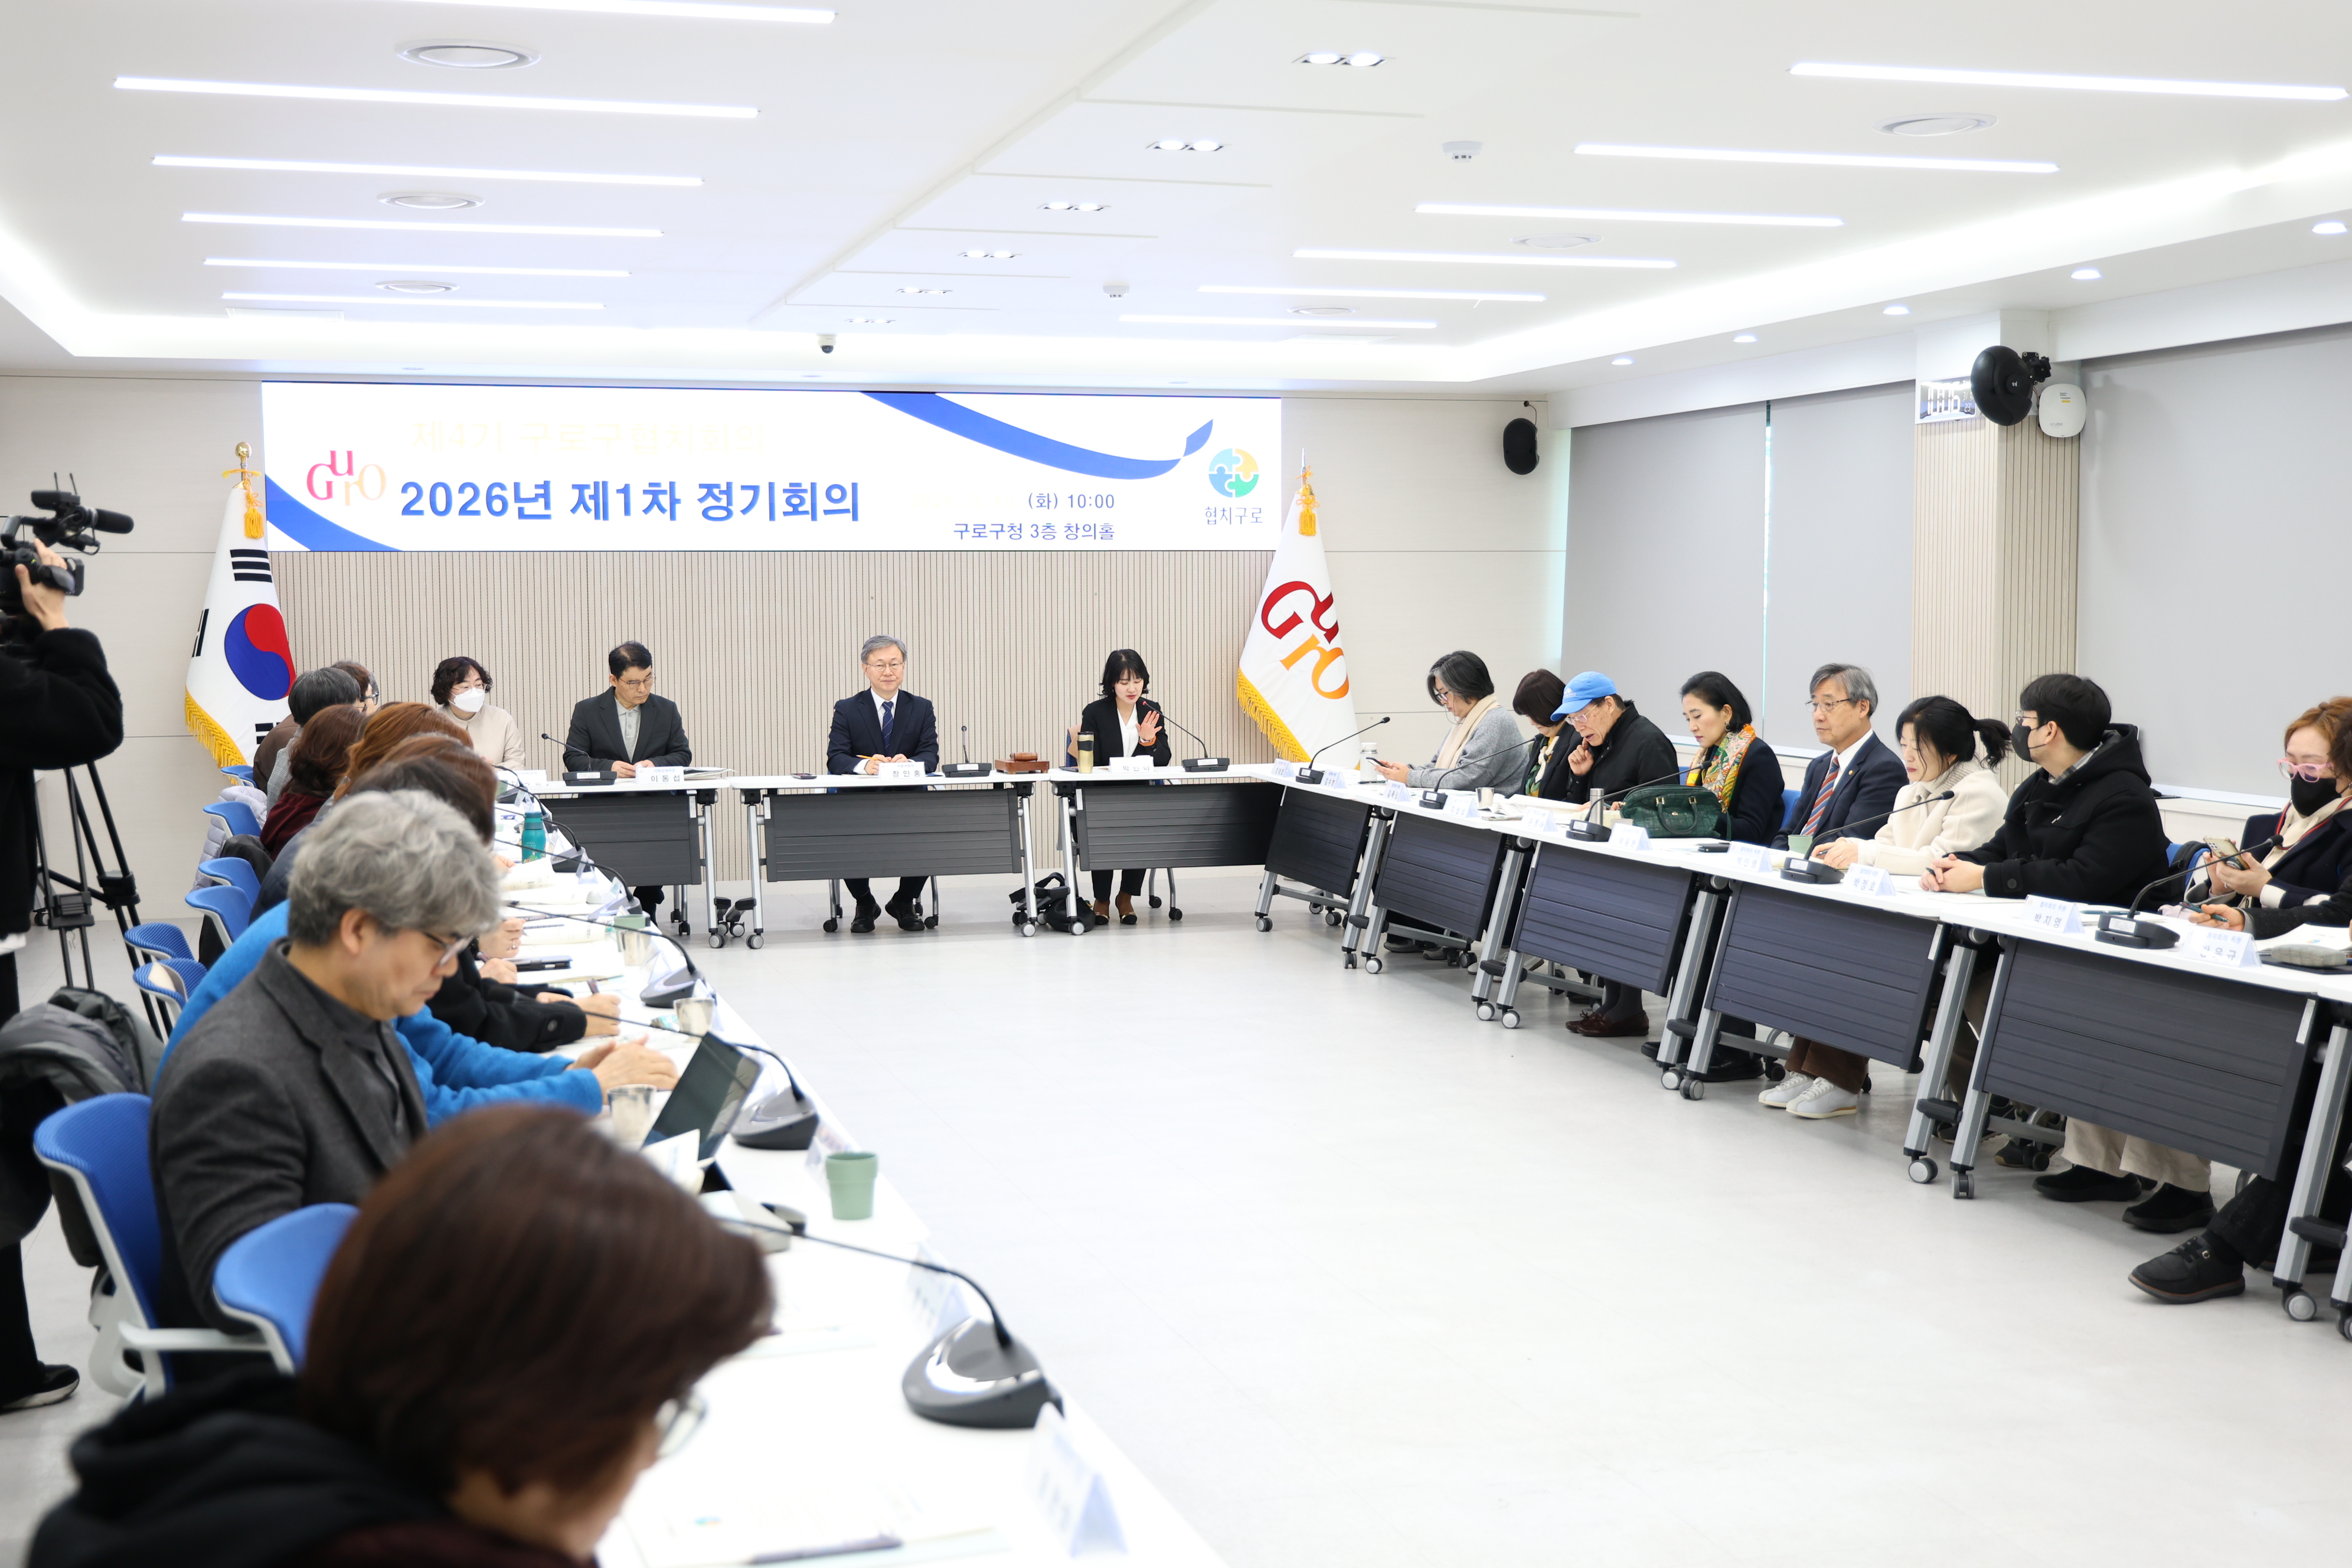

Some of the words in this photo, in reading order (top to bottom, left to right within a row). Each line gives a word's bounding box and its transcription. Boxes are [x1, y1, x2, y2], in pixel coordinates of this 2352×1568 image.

[411, 420, 502, 453] 제4기
[520, 422, 763, 456] 구로구협치회의
[400, 480, 553, 521] 2026년
[569, 481, 682, 521] 제1차
[696, 481, 860, 522] 정기회의
[1028, 493, 1059, 510] (화)
[1067, 494, 1115, 509] 10:00
[1204, 506, 1263, 525] 협치구로
[953, 522, 1023, 541] 구로구청
[1030, 522, 1057, 541] 3층
[1064, 522, 1115, 541] 창의홀
[2034, 913, 2063, 929] 박지영
